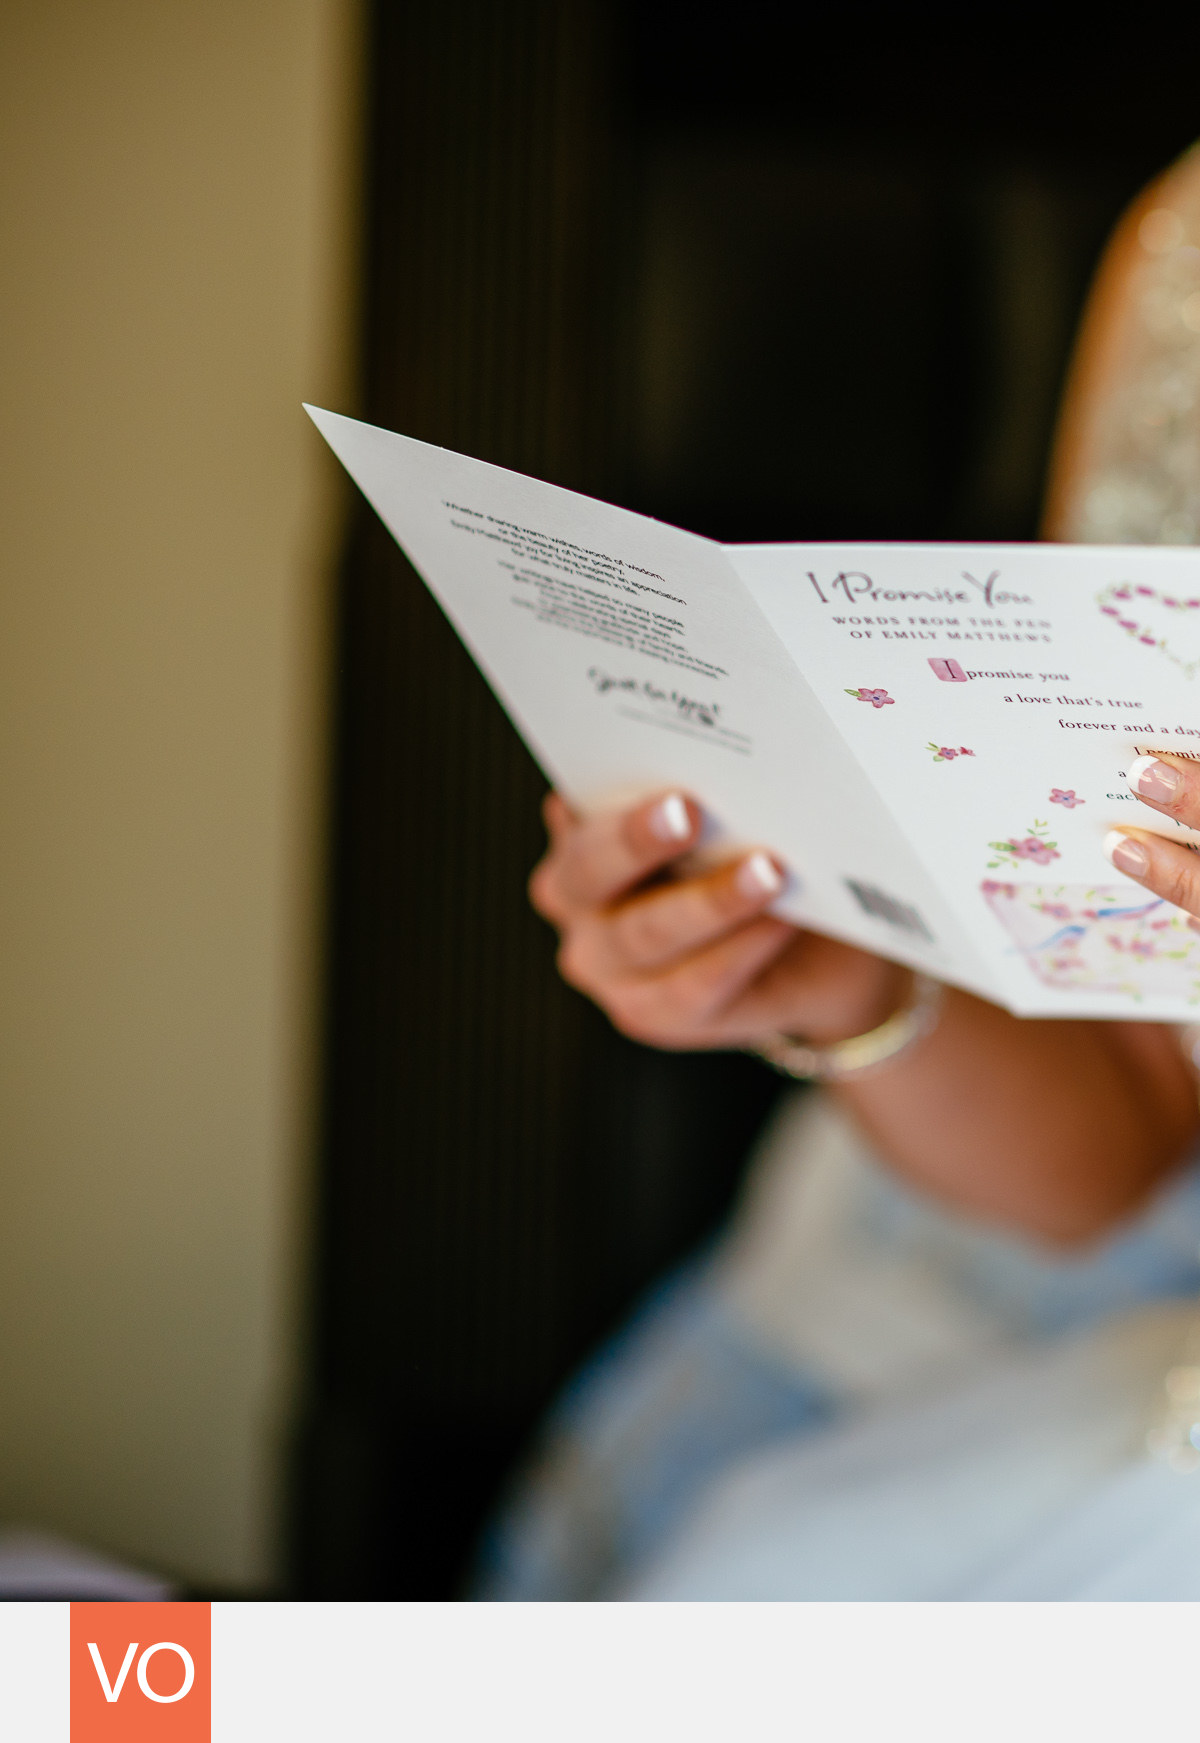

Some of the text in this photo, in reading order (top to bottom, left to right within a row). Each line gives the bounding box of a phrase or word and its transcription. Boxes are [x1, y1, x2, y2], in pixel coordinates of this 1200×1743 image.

[806, 569, 1036, 609] I Promise You
[832, 615, 901, 626] WORDS
[907, 616, 961, 627] FROM
[967, 617, 1007, 628] THE
[849, 630, 1053, 644] OF EMILY MATTHEWS
[966, 669, 1035, 681] promise
[1038, 671, 1071, 683] you
[1003, 693, 1144, 709] a love that's true
[1058, 718, 1118, 731] forever
[1123, 723, 1155, 734] and
[1133, 746, 1143, 756] I
[1106, 792, 1139, 801] eac
